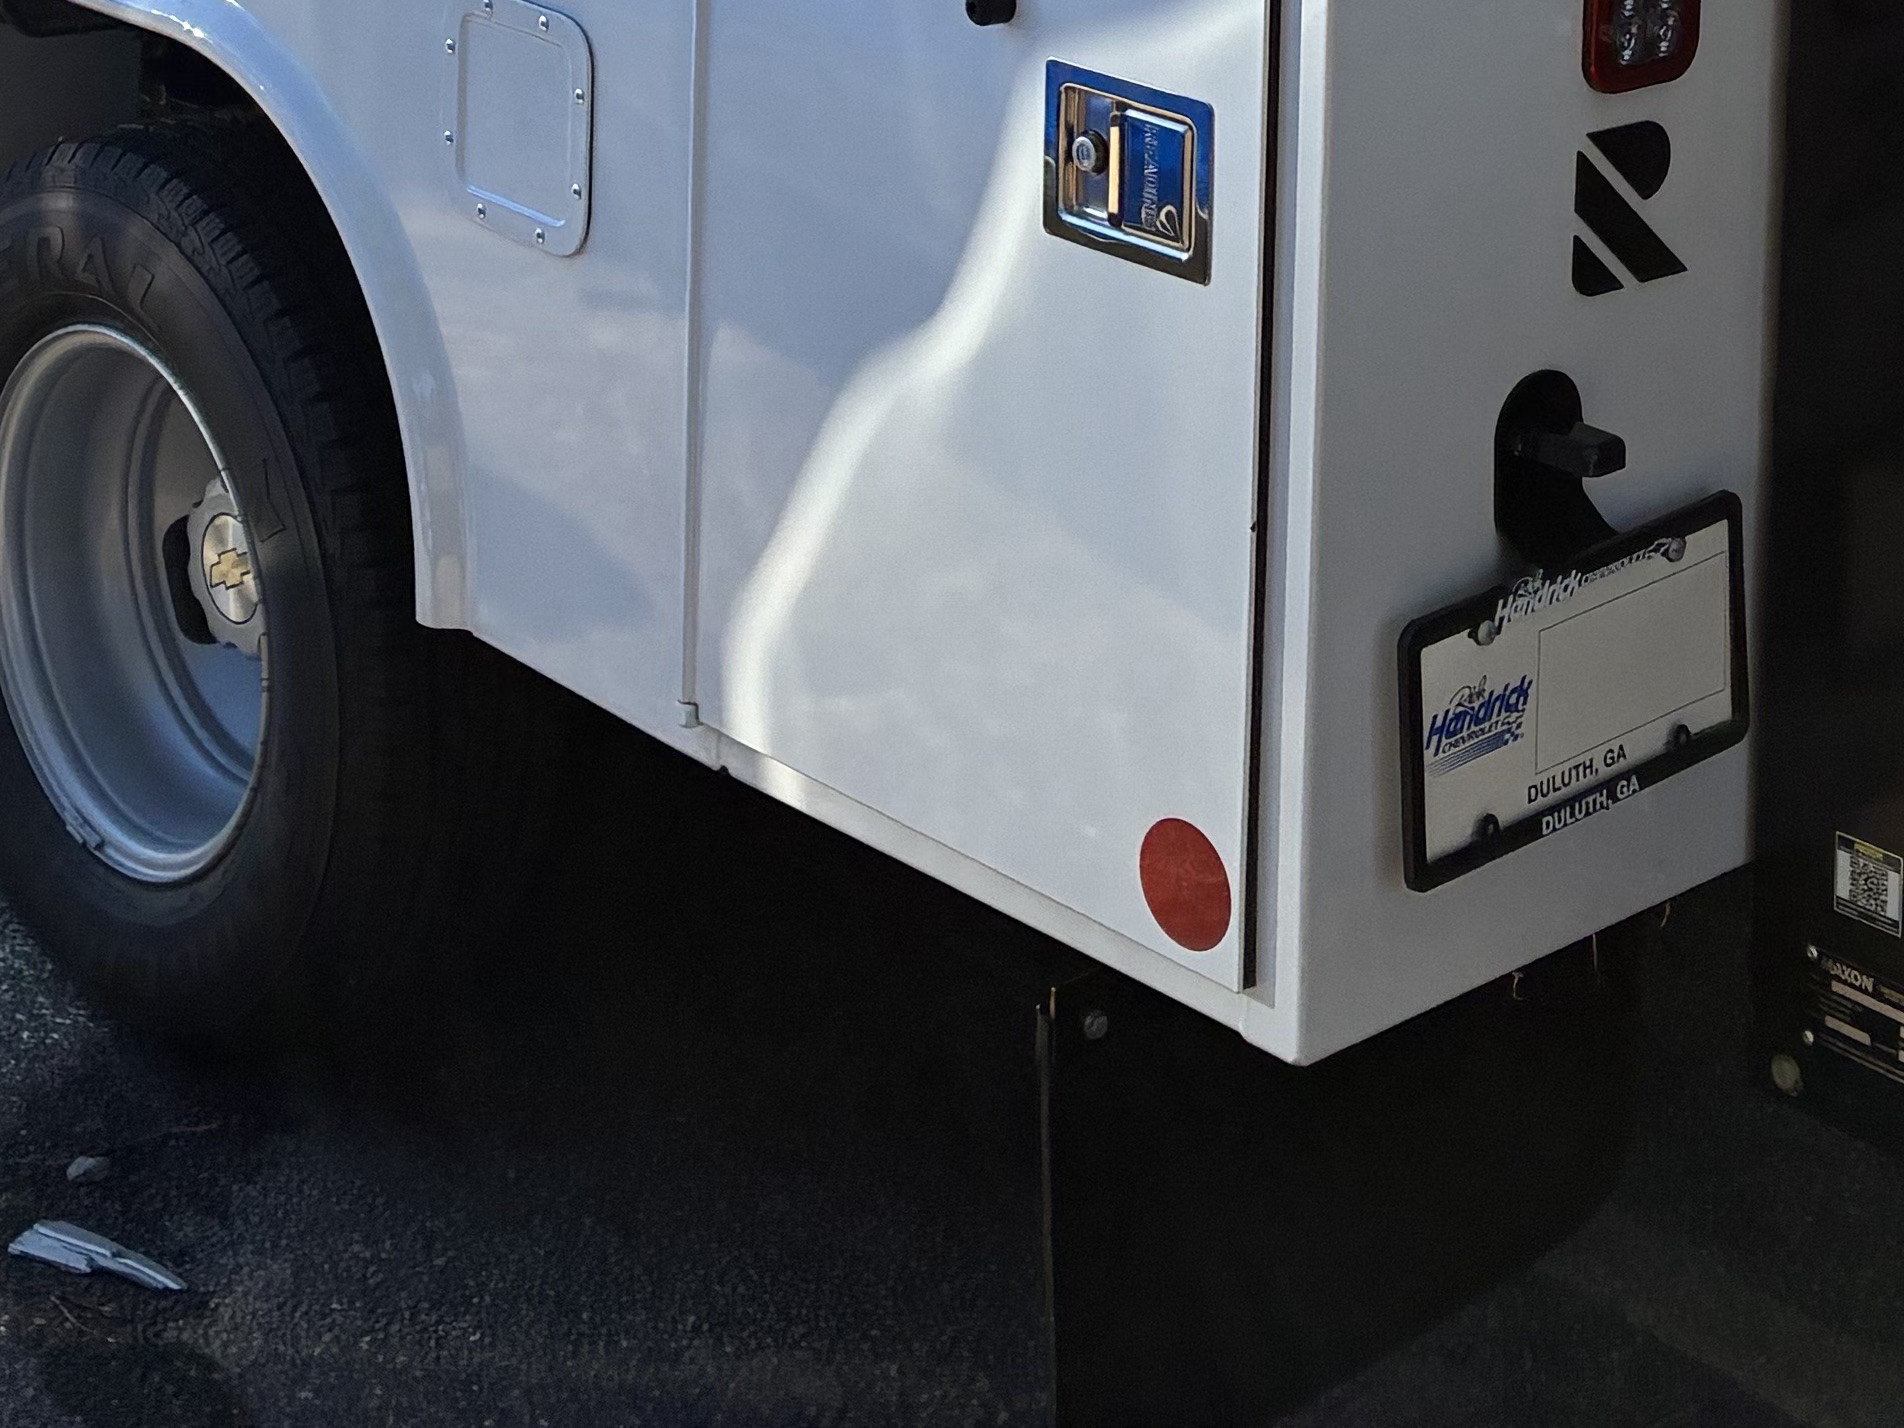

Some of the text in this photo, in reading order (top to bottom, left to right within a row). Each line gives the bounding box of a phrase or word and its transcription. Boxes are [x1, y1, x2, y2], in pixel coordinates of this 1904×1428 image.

[1527, 744, 1628, 806] DULUTH, GA
[1541, 775, 1641, 836] DULUTH, GA
